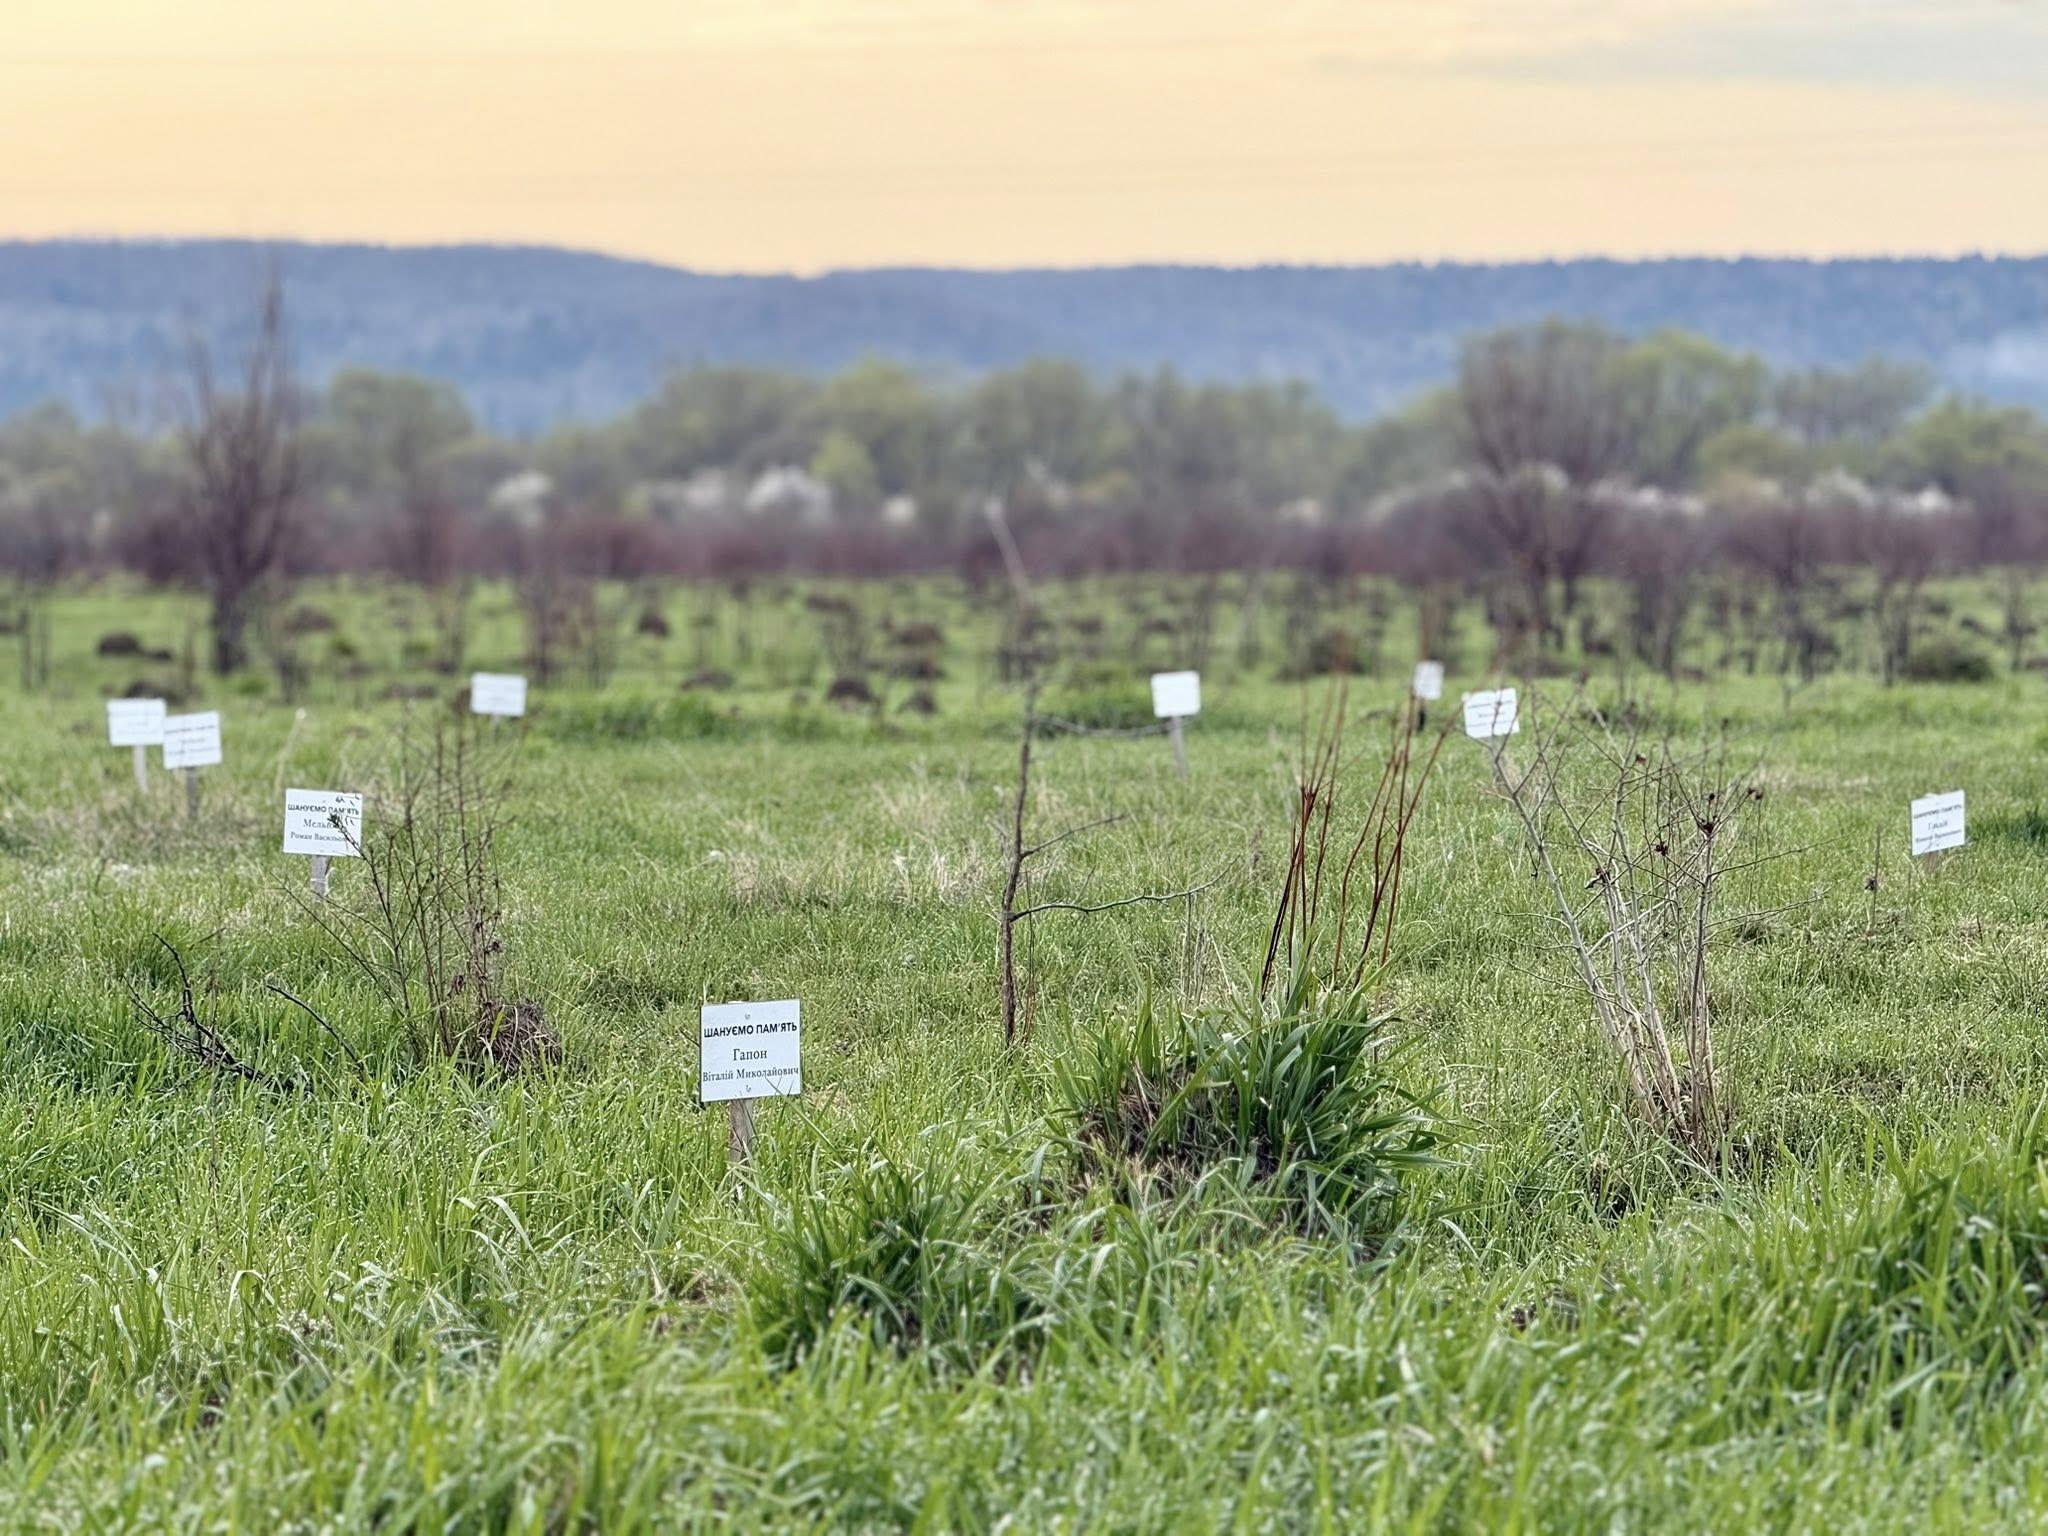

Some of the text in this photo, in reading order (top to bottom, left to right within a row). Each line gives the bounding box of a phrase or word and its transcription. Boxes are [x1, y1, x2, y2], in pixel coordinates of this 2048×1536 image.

[704, 1022, 798, 1038] ШАНУЄМО ПАМ'ЯТЬ
[733, 1048, 767, 1061] Гапон
[703, 1067, 799, 1082] Віталій Миколайович
